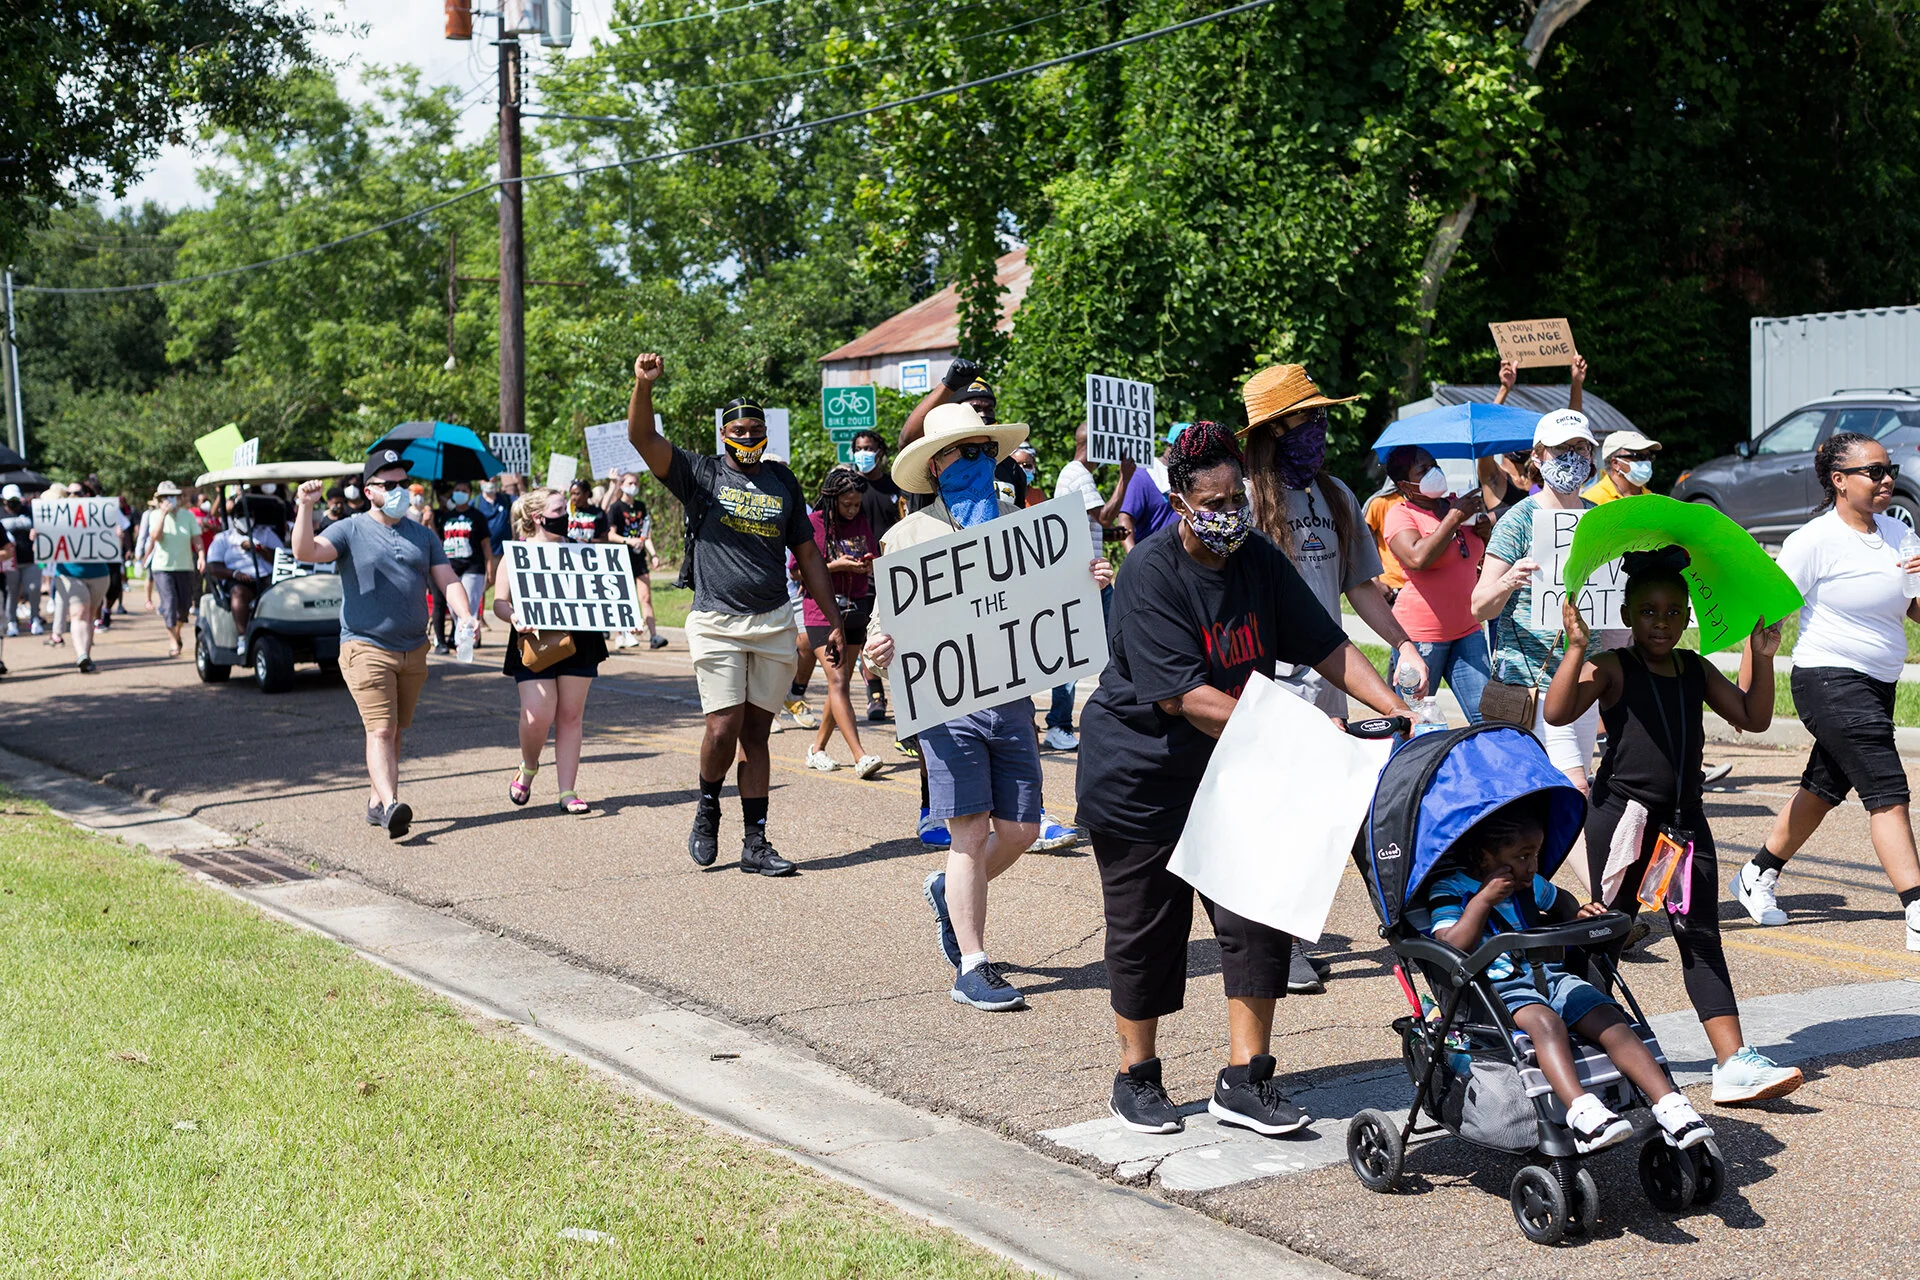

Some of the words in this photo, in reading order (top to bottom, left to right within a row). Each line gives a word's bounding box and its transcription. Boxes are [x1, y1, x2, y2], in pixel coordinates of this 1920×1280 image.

[1494, 325, 1503, 334] I
[1507, 323, 1534, 333] KNOW
[1538, 320, 1563, 331] THAT
[1500, 335, 1508, 344] A
[1511, 331, 1563, 344] CHANGE
[1539, 342, 1570, 356] COME
[1092, 378, 1150, 411] BLACK
[828, 417, 845, 426] BIKE
[847, 416, 872, 425] ROUTE
[1096, 406, 1148, 438] LIVES
[492, 435, 528, 448] BLACK
[1092, 433, 1152, 466] MATTER
[503, 461, 529, 474] TTER
[718, 485, 783, 510] SOUTHERN
[36, 502, 117, 528] #MARC
[734, 503, 763, 520] MISS
[1287, 516, 1336, 532] TAGONI
[36, 530, 119, 561] DAVIS
[512, 545, 624, 572] BLACK
[889, 513, 1069, 616] DEFUND
[525, 573, 622, 601] LIVES
[1687, 571, 1713, 600] our
[521, 601, 636, 627] MATTER
[970, 591, 1008, 618] THE
[1704, 603, 1729, 644] Let
[1211, 611, 1265, 669] Can't
[901, 599, 1090, 721] POLICE
